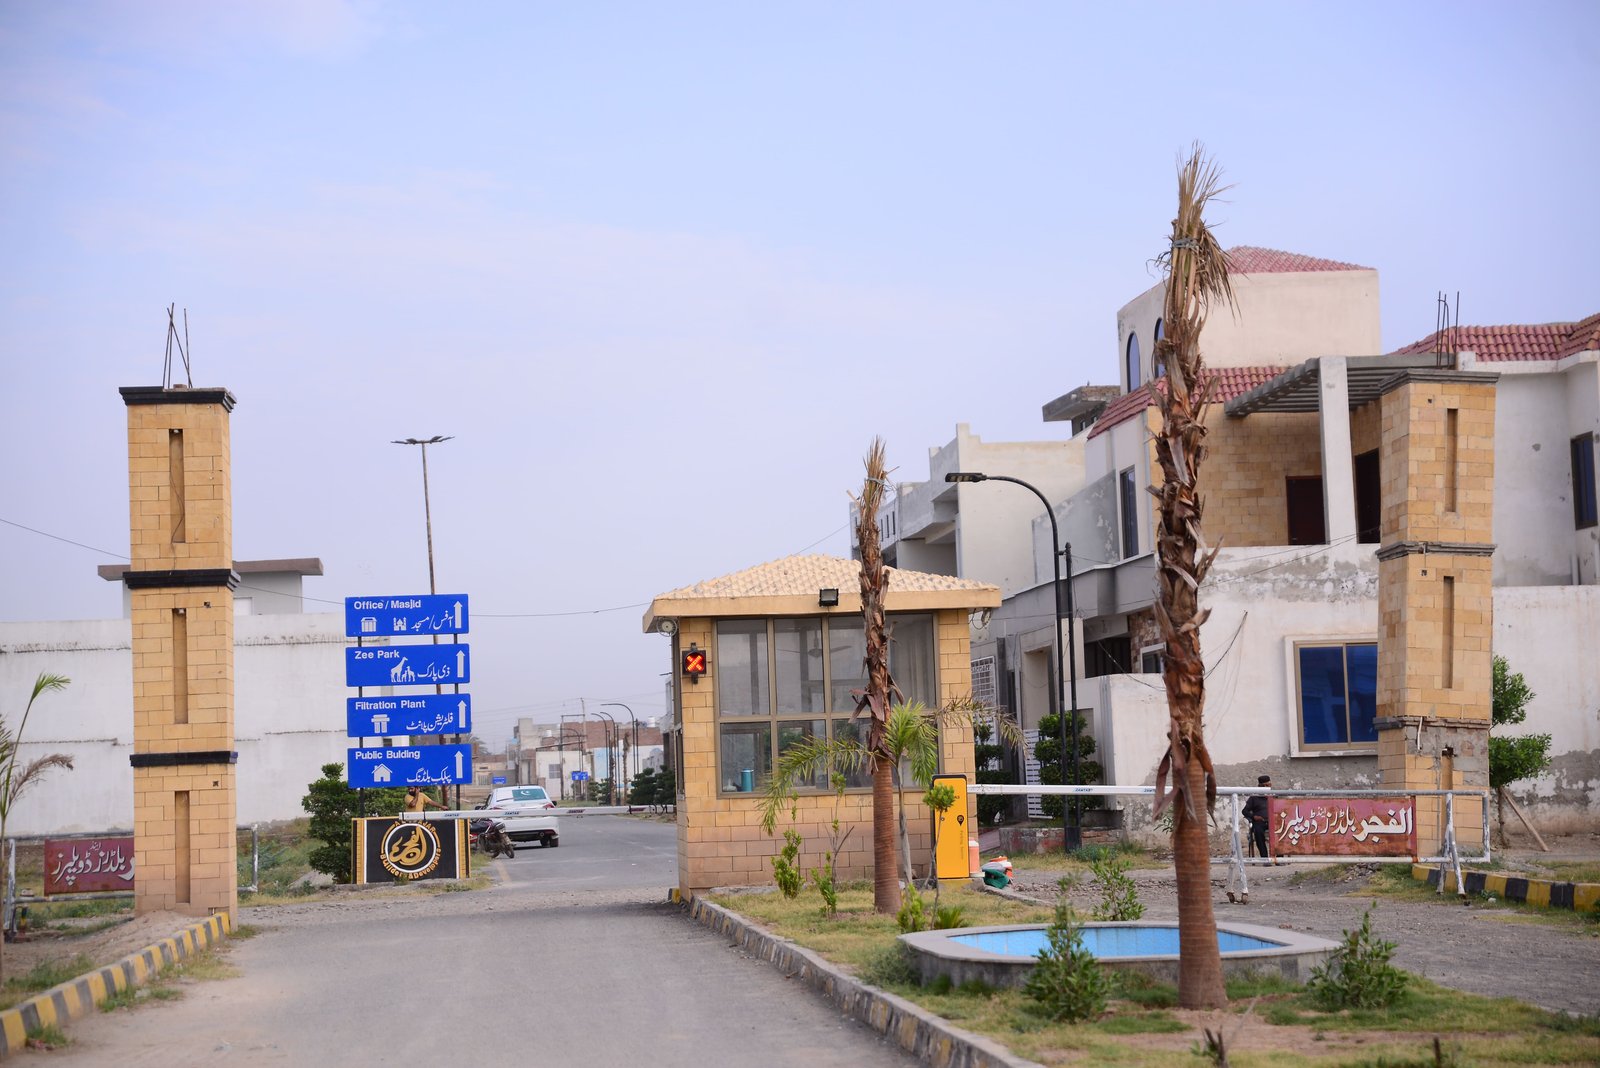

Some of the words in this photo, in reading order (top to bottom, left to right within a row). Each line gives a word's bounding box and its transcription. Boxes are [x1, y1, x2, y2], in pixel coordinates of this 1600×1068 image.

[354, 600, 383, 610] Office
[390, 599, 422, 609] Masjid
[354, 651, 374, 660] Zee
[377, 649, 400, 659] Park
[355, 701, 397, 711] Filtration
[400, 700, 426, 709] Plant
[355, 751, 383, 760] Public
[1353, 805, 1413, 843] الفجر
